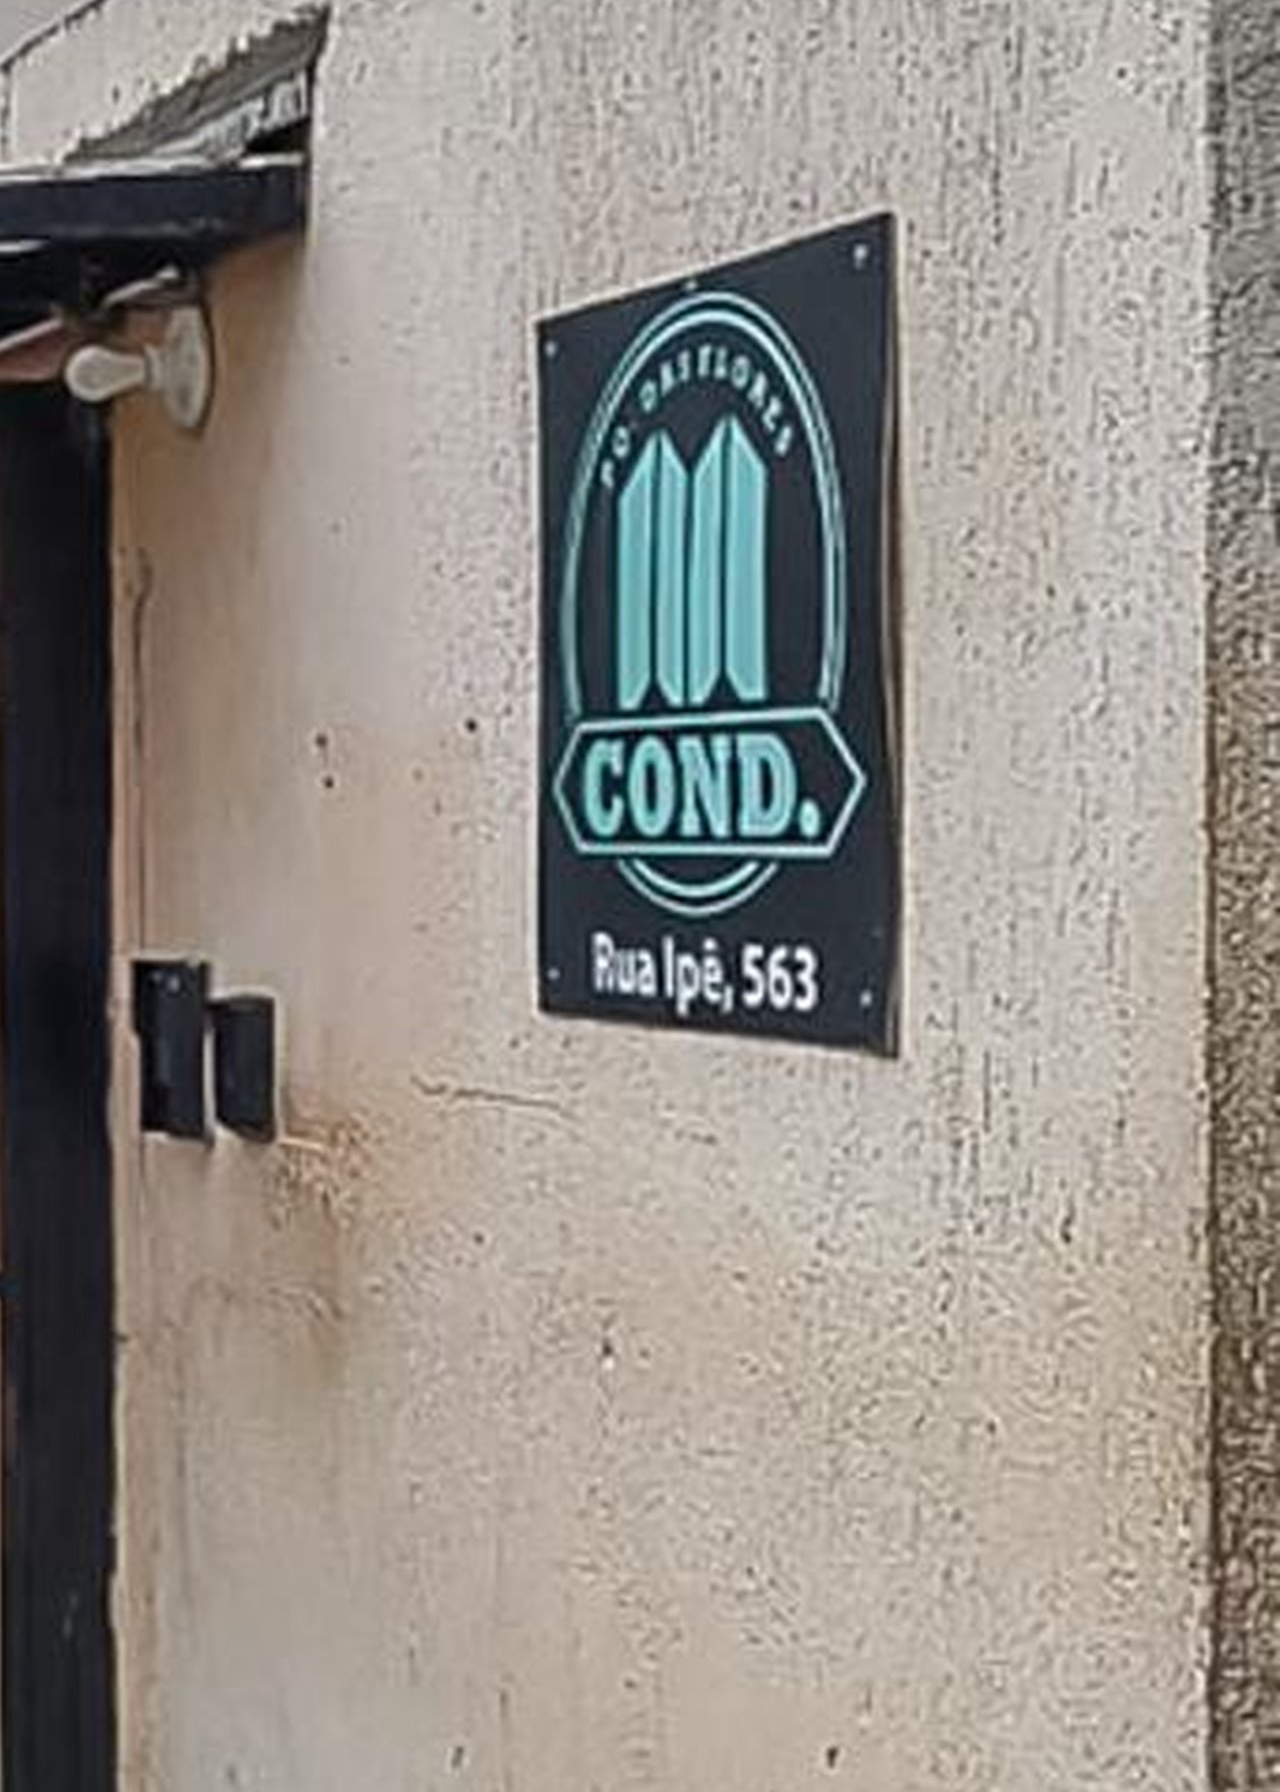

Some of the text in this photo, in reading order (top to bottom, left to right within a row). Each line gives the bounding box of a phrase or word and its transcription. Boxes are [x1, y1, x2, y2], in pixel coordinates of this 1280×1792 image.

[584, 731, 821, 838] COND.
[592, 931, 819, 1018] Rua Ipê, 563
